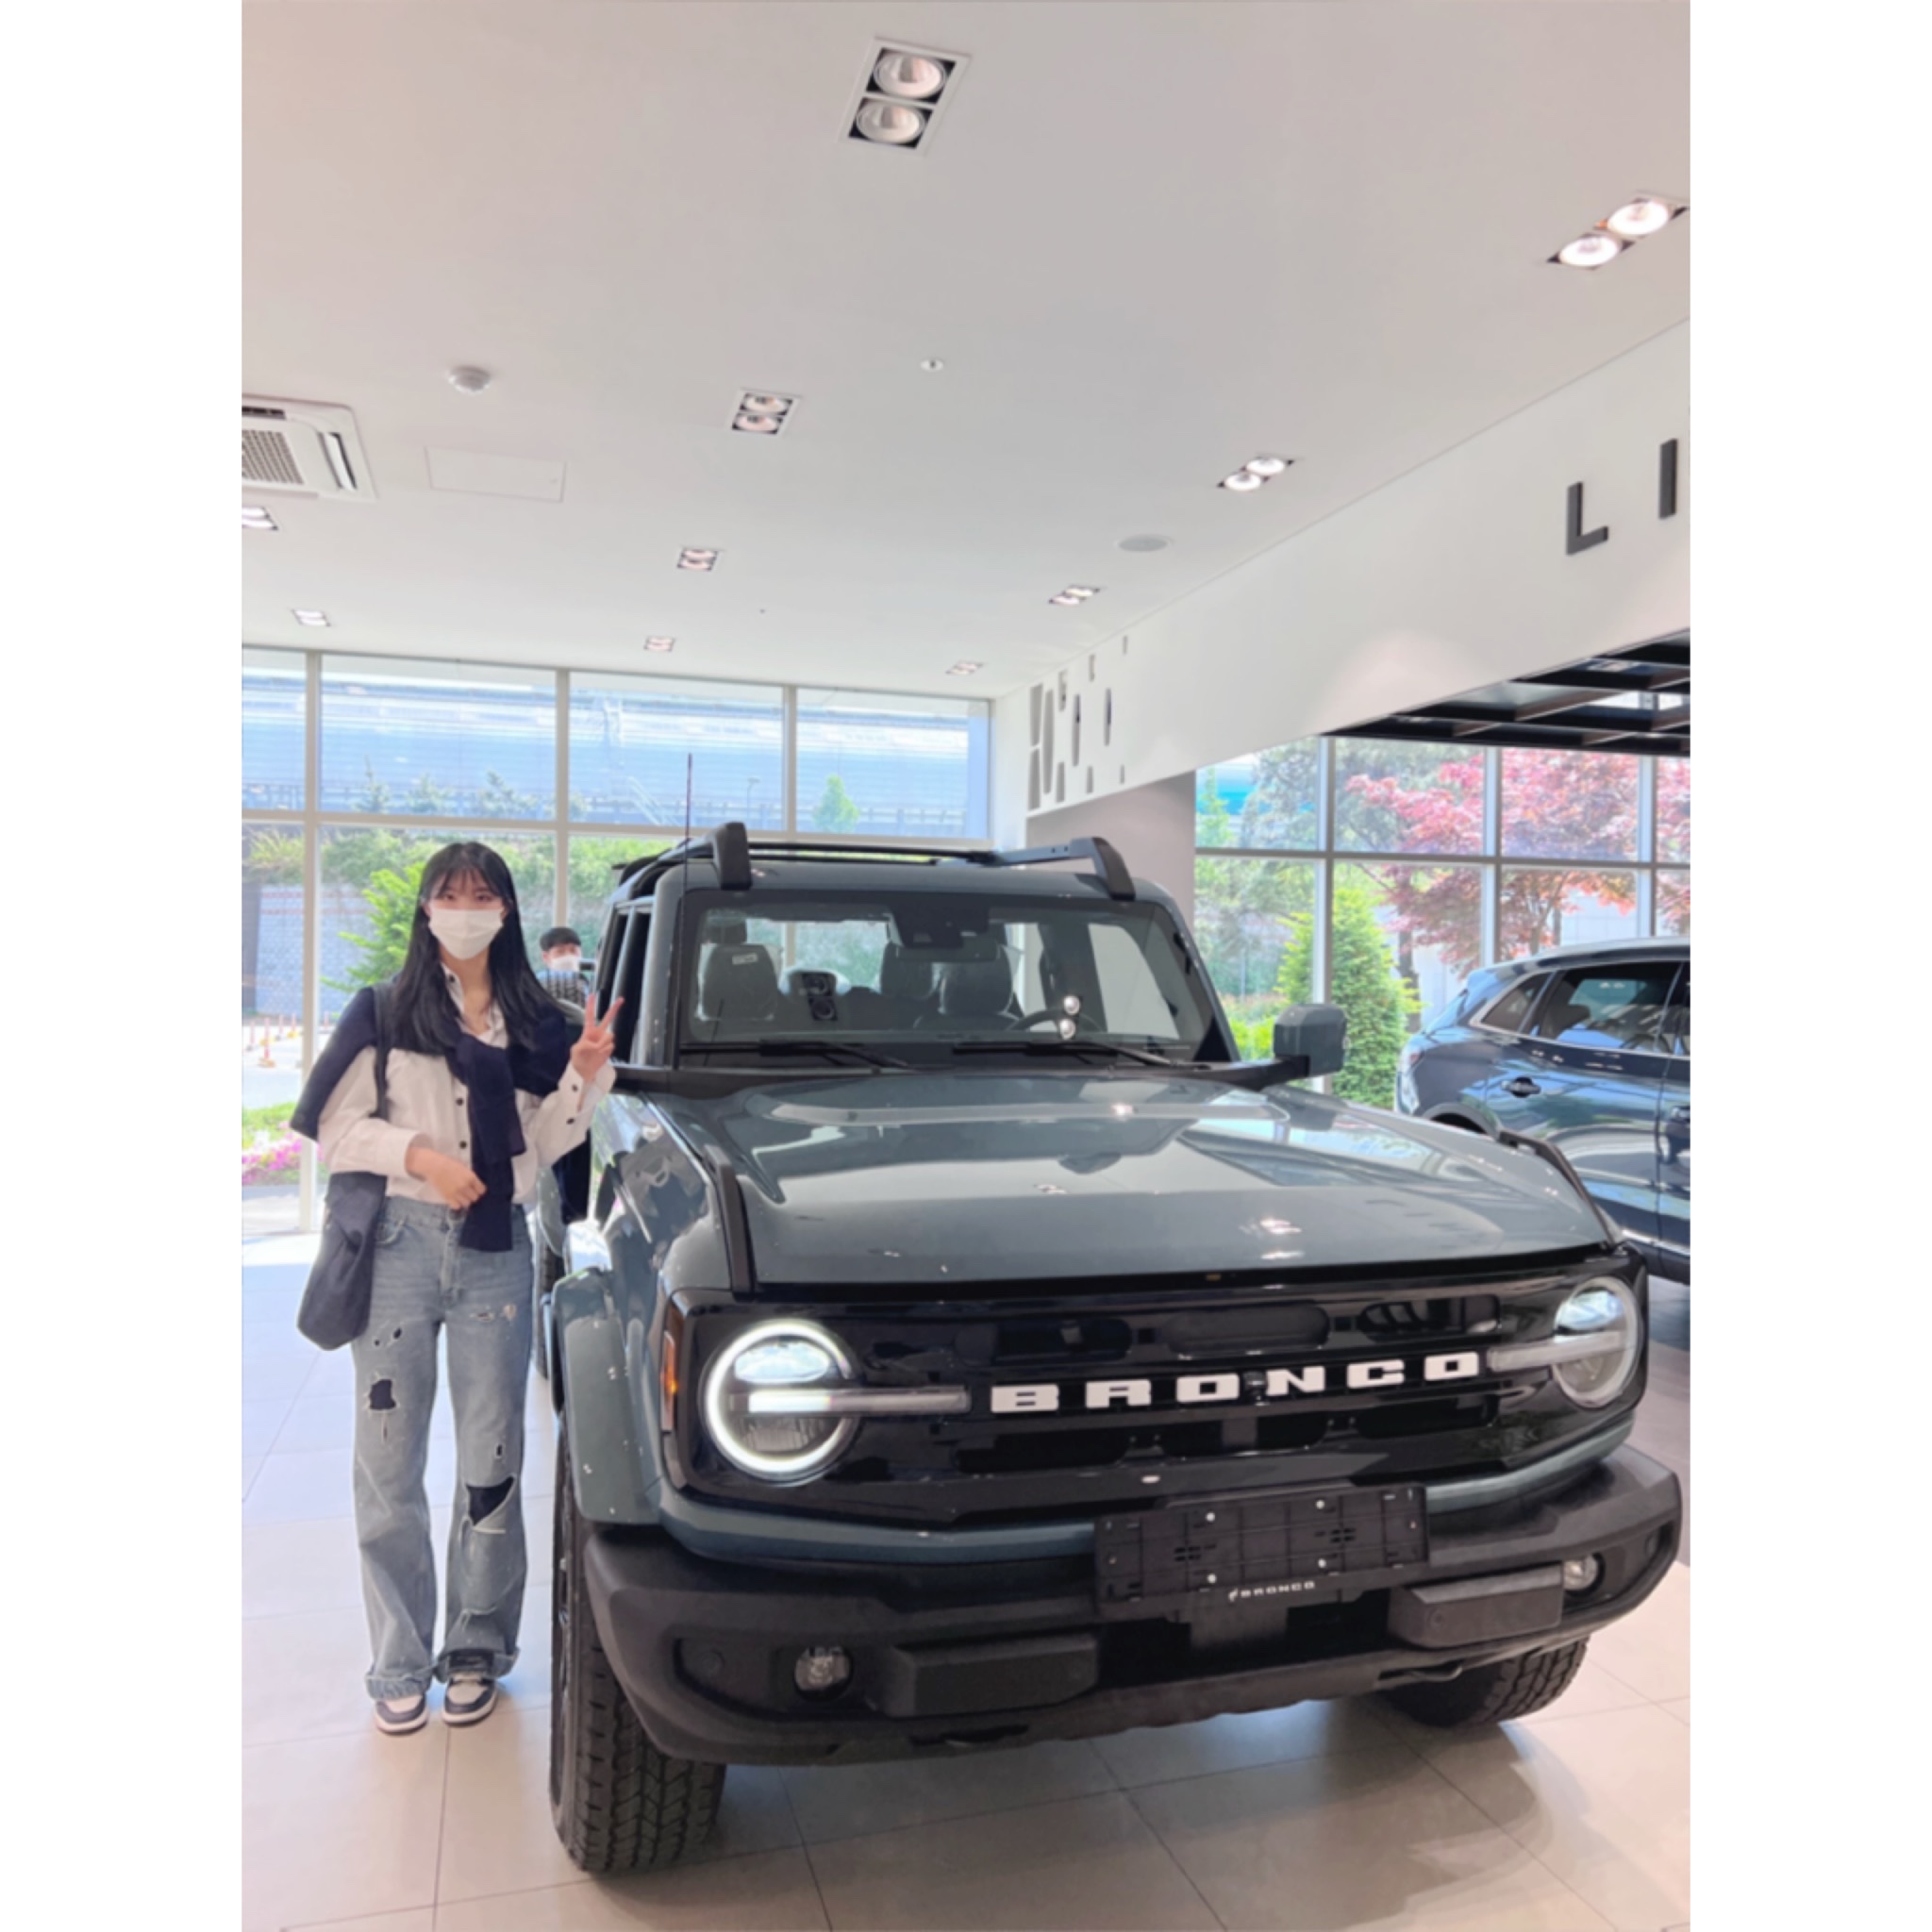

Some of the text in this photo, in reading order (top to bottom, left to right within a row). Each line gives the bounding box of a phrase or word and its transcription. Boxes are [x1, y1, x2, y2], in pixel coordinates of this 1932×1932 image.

[1566, 438, 1677, 555] LI
[991, 1352, 1479, 1413] BRONCO
[1241, 1581, 1315, 1598] BRONCO
